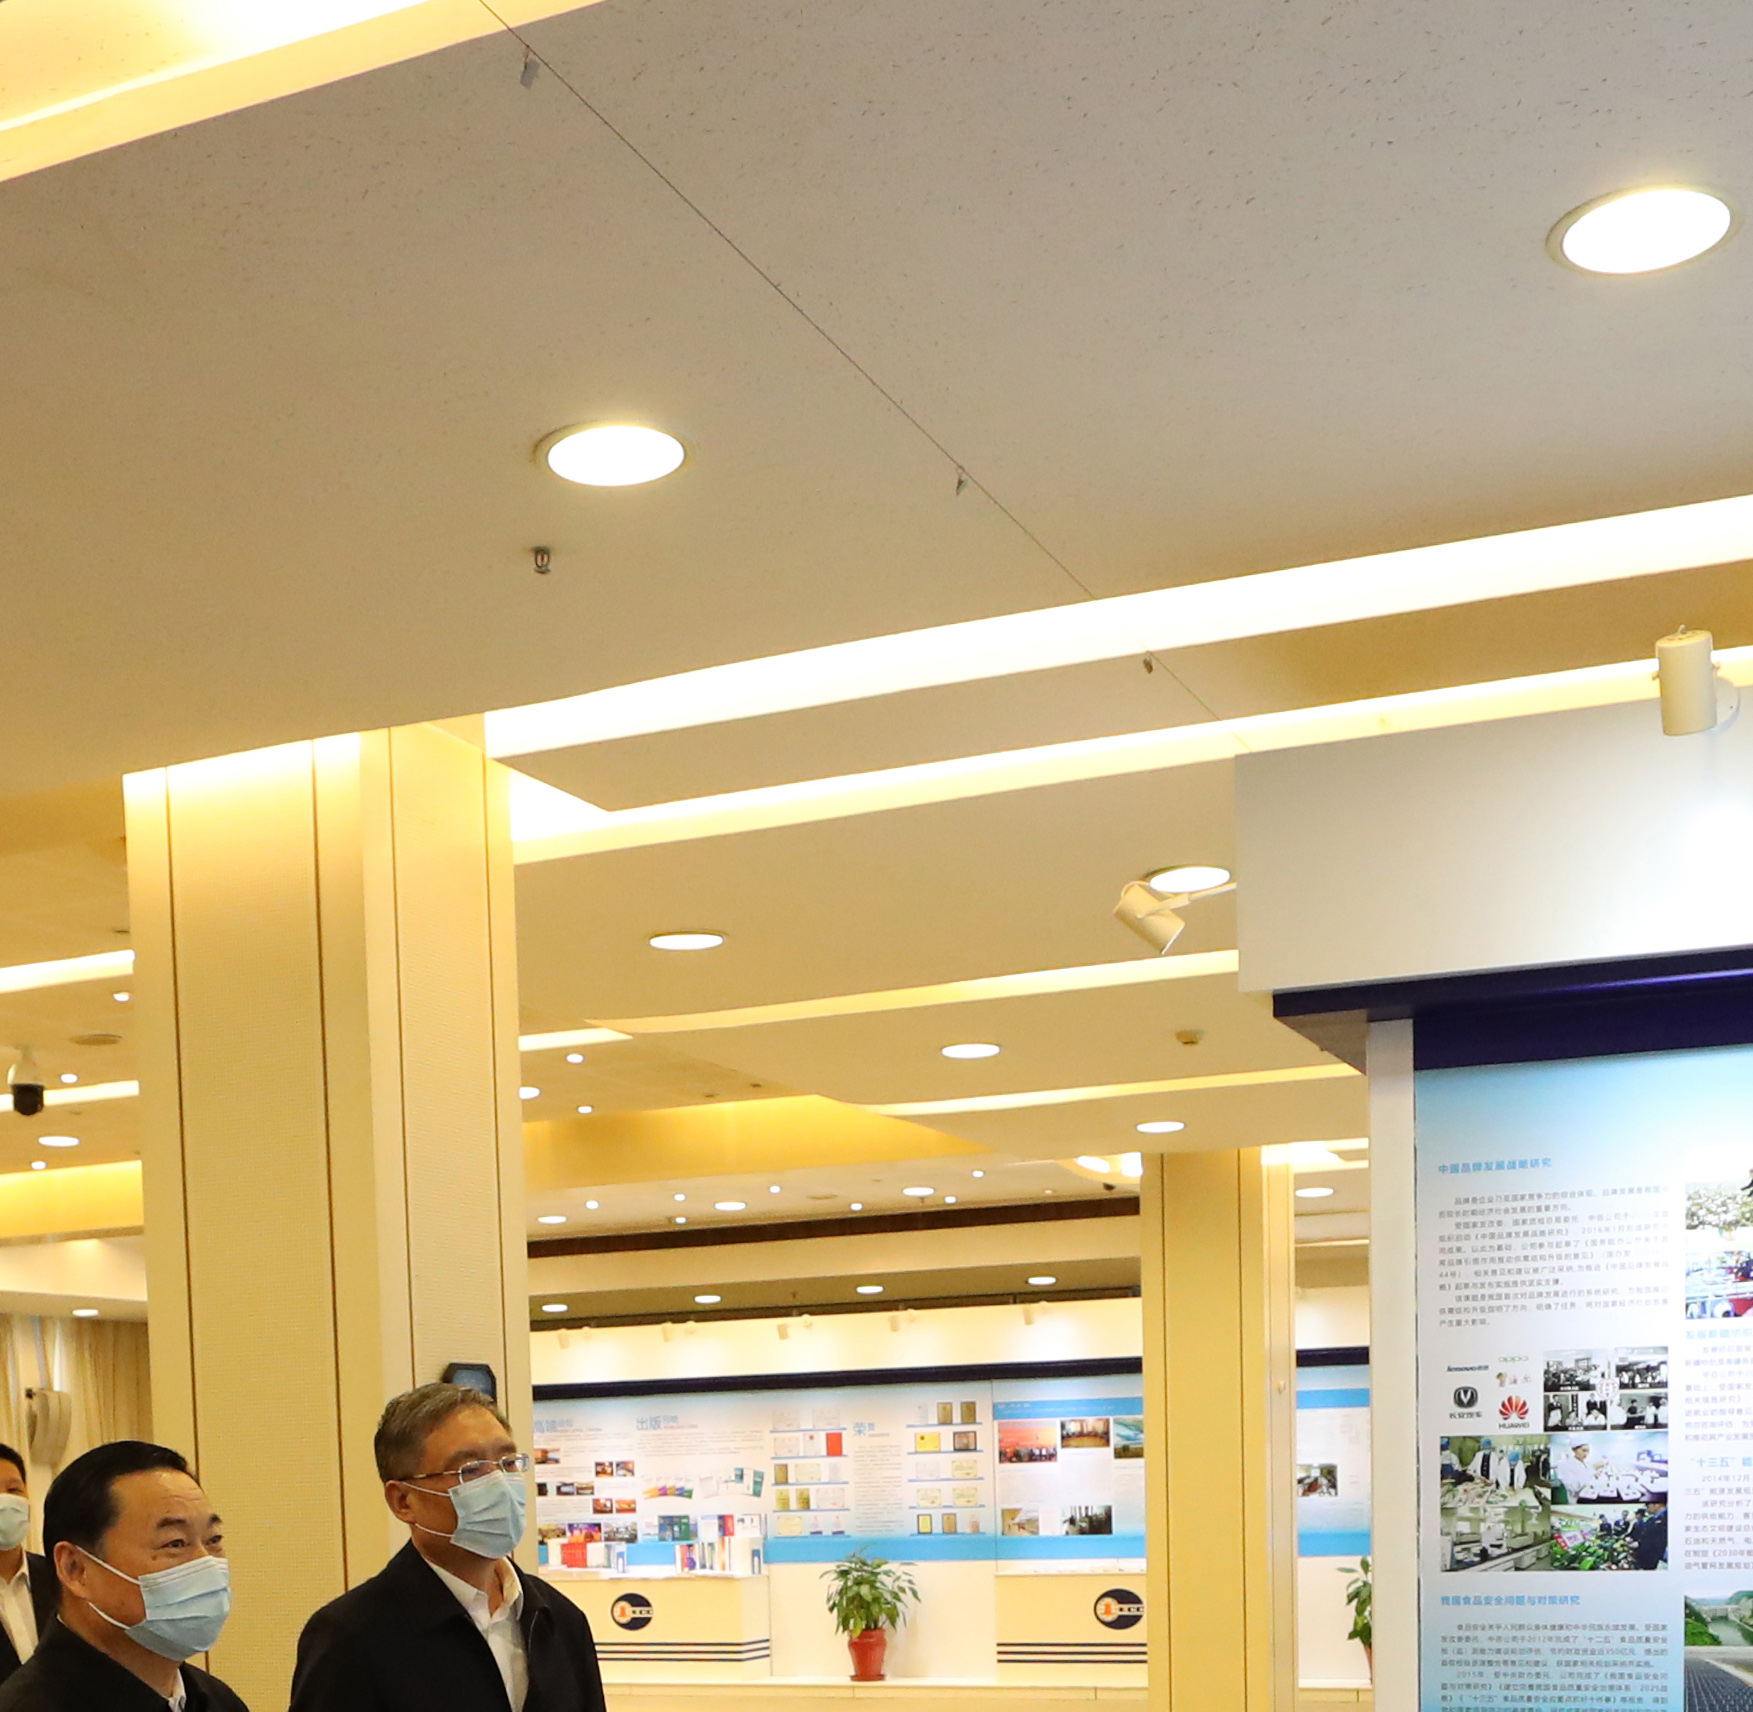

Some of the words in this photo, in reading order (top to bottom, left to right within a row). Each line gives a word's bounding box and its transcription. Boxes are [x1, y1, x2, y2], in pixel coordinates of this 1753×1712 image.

[1438, 1157, 1552, 1174] 中国品牌发展战略研究
[1441, 1594, 1581, 1606] 我国食品安全问题与对策研究
